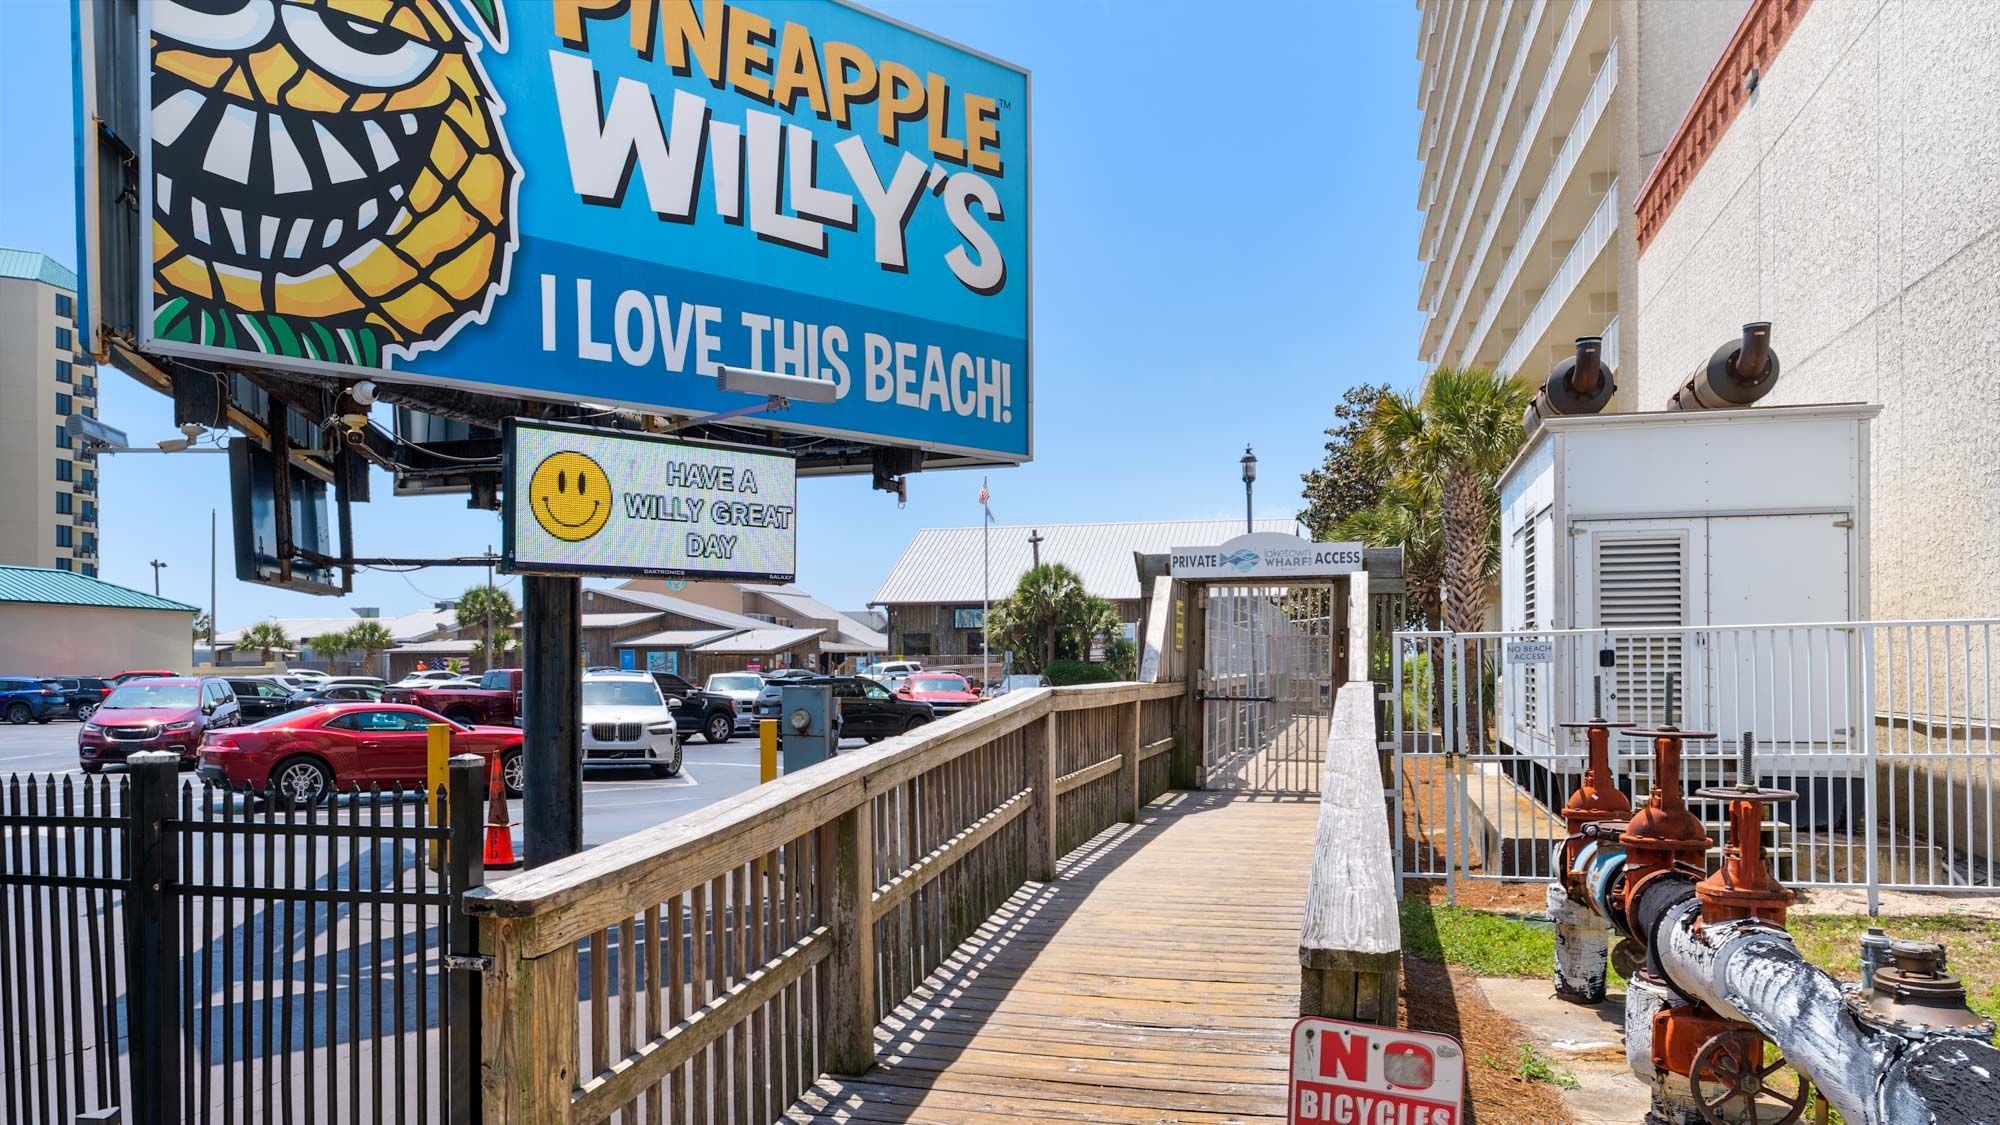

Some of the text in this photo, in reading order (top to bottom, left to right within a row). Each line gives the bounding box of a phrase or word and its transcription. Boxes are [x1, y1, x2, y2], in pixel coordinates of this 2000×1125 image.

[549, 49, 1007, 296] WILLY'S
[541, 274, 1011, 423] I LOVE THIS BEACH!
[667, 461, 758, 493] HAVE A
[624, 493, 793, 529] WILLY GREAT
[686, 532, 737, 559] DAY
[1172, 554, 1217, 568] PRIVATE
[1264, 557, 1308, 567] WHARF
[1314, 551, 1360, 565] ACCESS
[643, 568, 686, 576] DAKTRONICS
[1523, 645, 1552, 653] BEACH
